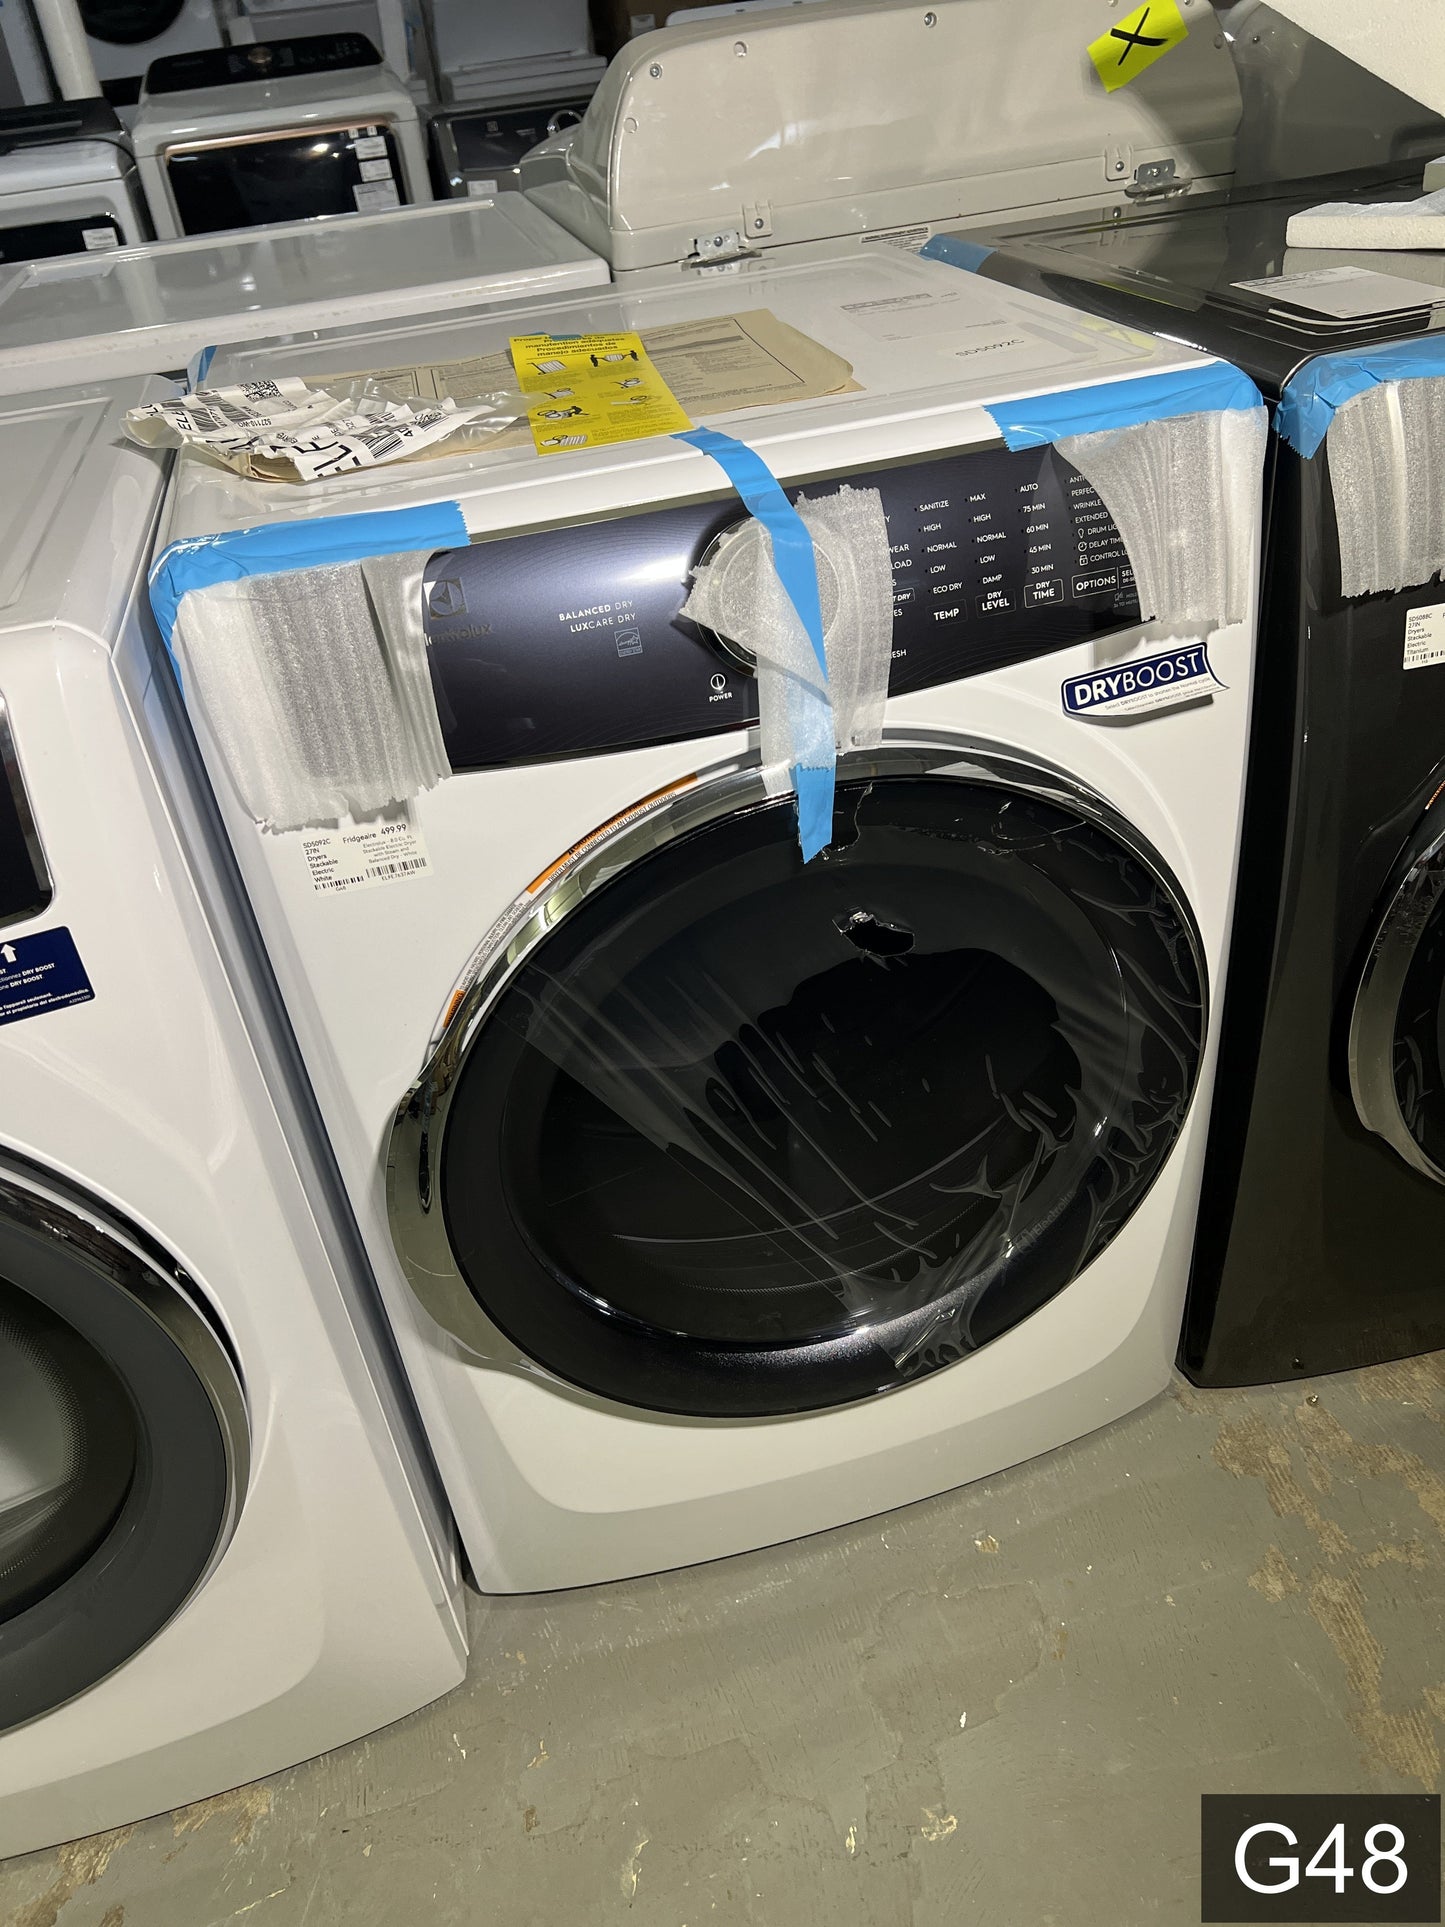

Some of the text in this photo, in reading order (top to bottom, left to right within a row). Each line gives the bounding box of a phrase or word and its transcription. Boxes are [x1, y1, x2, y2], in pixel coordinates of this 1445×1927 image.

[1020, 483, 1038, 492] AUTO
[970, 493, 986, 502] MAX
[920, 500, 950, 512] SANITIZE
[1023, 502, 1046, 513] 75 MIN
[1073, 499, 1102, 510] WRINKLE
[974, 514, 992, 523] HIGH
[1075, 512, 1108, 523] EXTENDED
[923, 523, 942, 532] HIGH
[1026, 523, 1049, 534] 60 MIN
[1088, 526, 1107, 535] DRUM
[977, 532, 1006, 543] NORMAL
[927, 541, 957, 553] NORMAL
[1038, 544, 1052, 552] MIN
[1089, 539, 1108, 548] DELAY
[980, 555, 996, 564] LOW
[1090, 551, 1120, 562] CONTROL
[930, 565, 946, 574] LOW
[1040, 564, 1054, 572] MIN
[982, 574, 1002, 584] DAMP
[1076, 576, 1117, 591] OPTIONS
[932, 582, 963, 594] ECO DRY
[1036, 581, 1050, 590] DRY
[897, 593, 911, 601] DRY
[987, 591, 1002, 600] DRY
[1033, 588, 1055, 600] TIME
[982, 598, 1010, 611] LEVEL
[558, 600, 634, 622] BALANCED DRY
[933, 608, 960, 621] TEMP
[570, 612, 637, 633] LUXCARE DRY
[1408, 633, 1432, 641] Stackable
[1074, 652, 1198, 706] DRYBOOST
[709, 692, 732, 702] POWER
[342, 824, 407, 844] Fridgeaire 499.99
[303, 839, 331, 848] SD5092C
[307, 854, 327, 862] Dryers
[310, 859, 338, 868] Stackable
[312, 867, 334, 876] Electric
[314, 875, 332, 883] White
[35, 963, 55, 973] BOOST
[10, 980, 22, 988] DRY
[23, 974, 43, 984] BOOST
